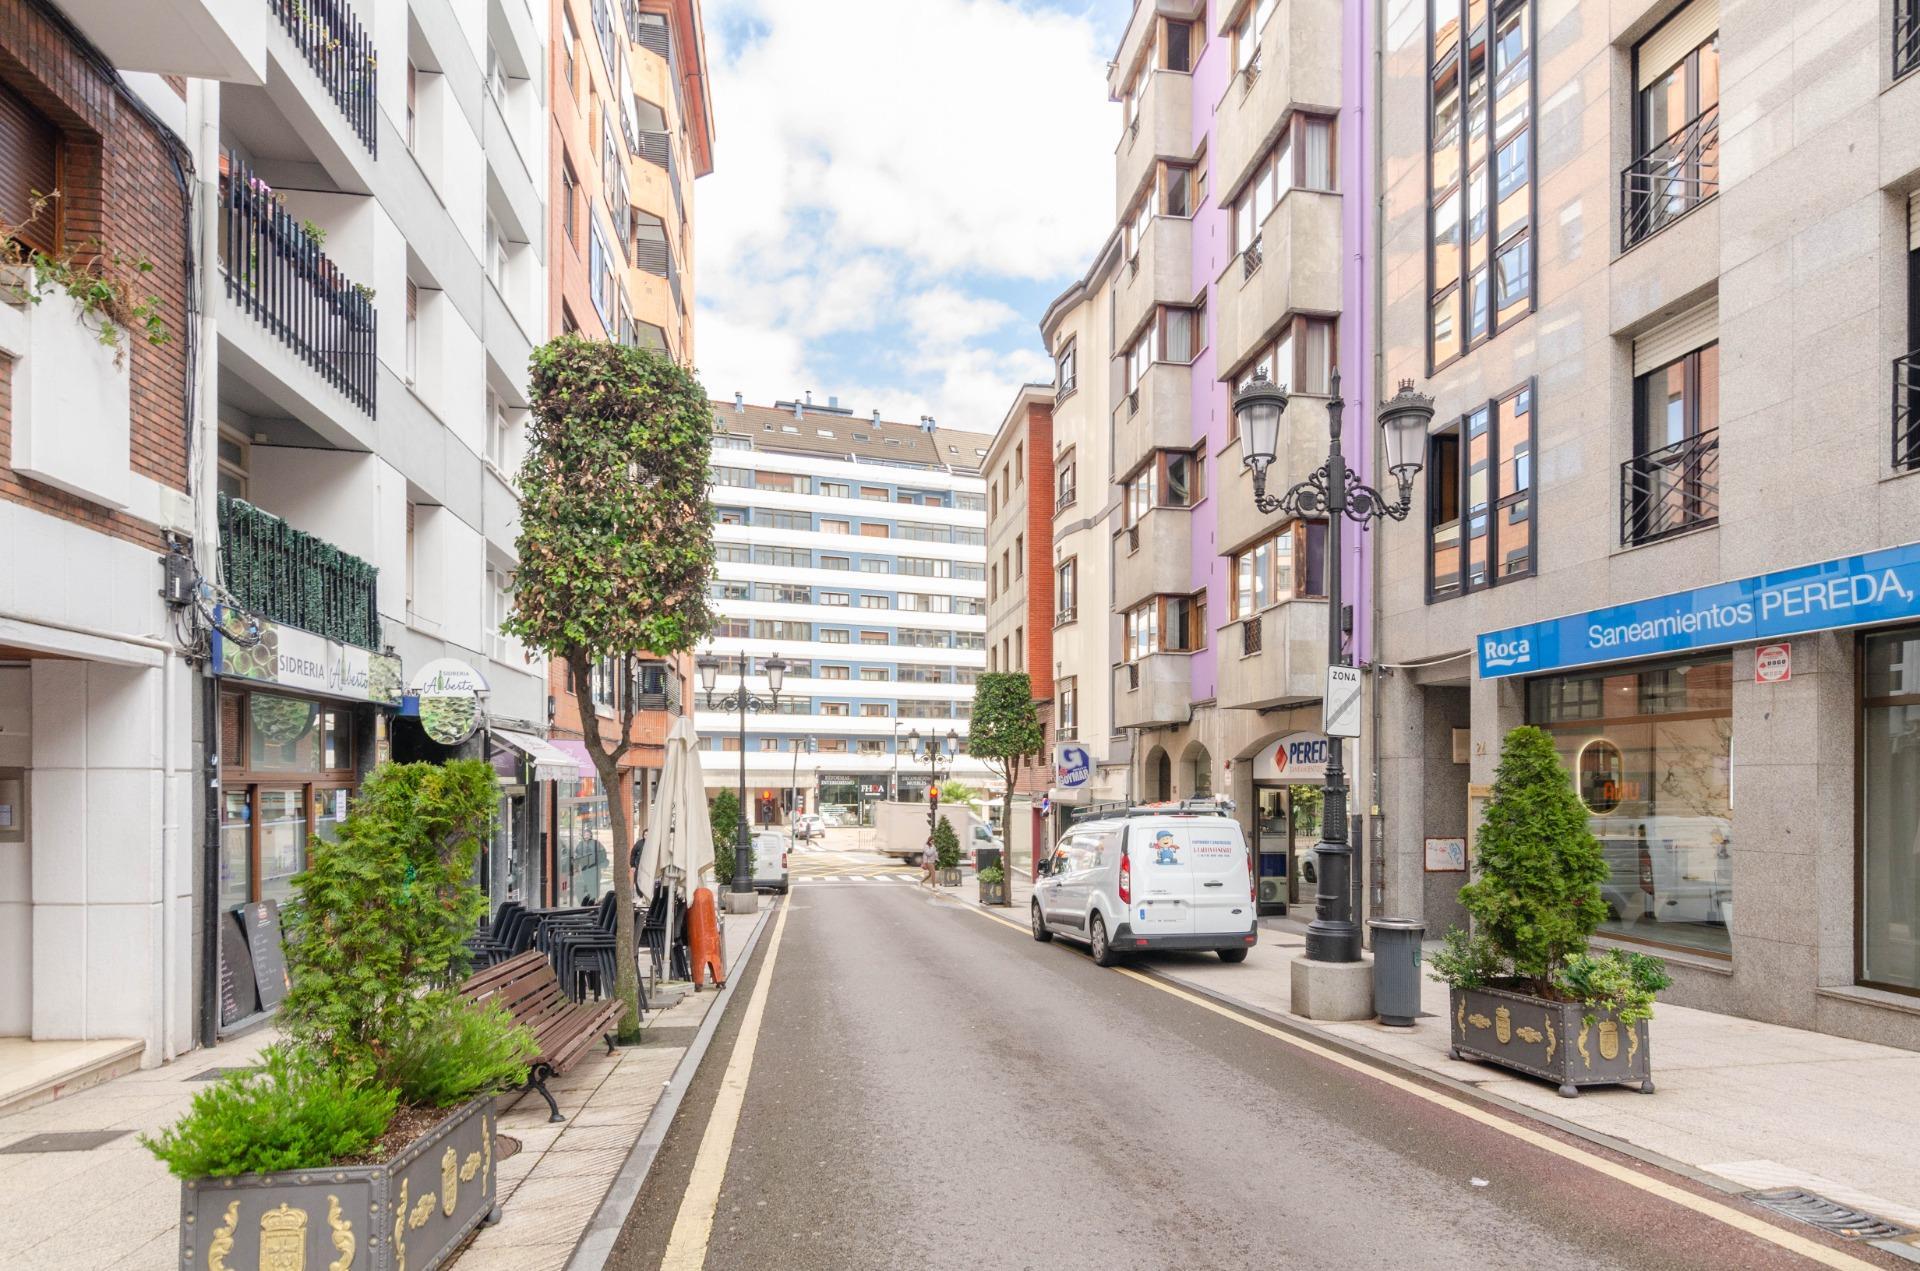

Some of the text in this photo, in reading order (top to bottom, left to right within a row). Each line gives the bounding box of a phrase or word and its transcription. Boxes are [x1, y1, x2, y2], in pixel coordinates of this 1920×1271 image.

[1588, 569, 1914, 649] Saneamientos PEREDA,
[1485, 636, 1530, 658] Roca
[279, 653, 325, 680] SIDRERIA
[1332, 671, 1357, 682] ZONA
[1289, 741, 1328, 764] PERED
